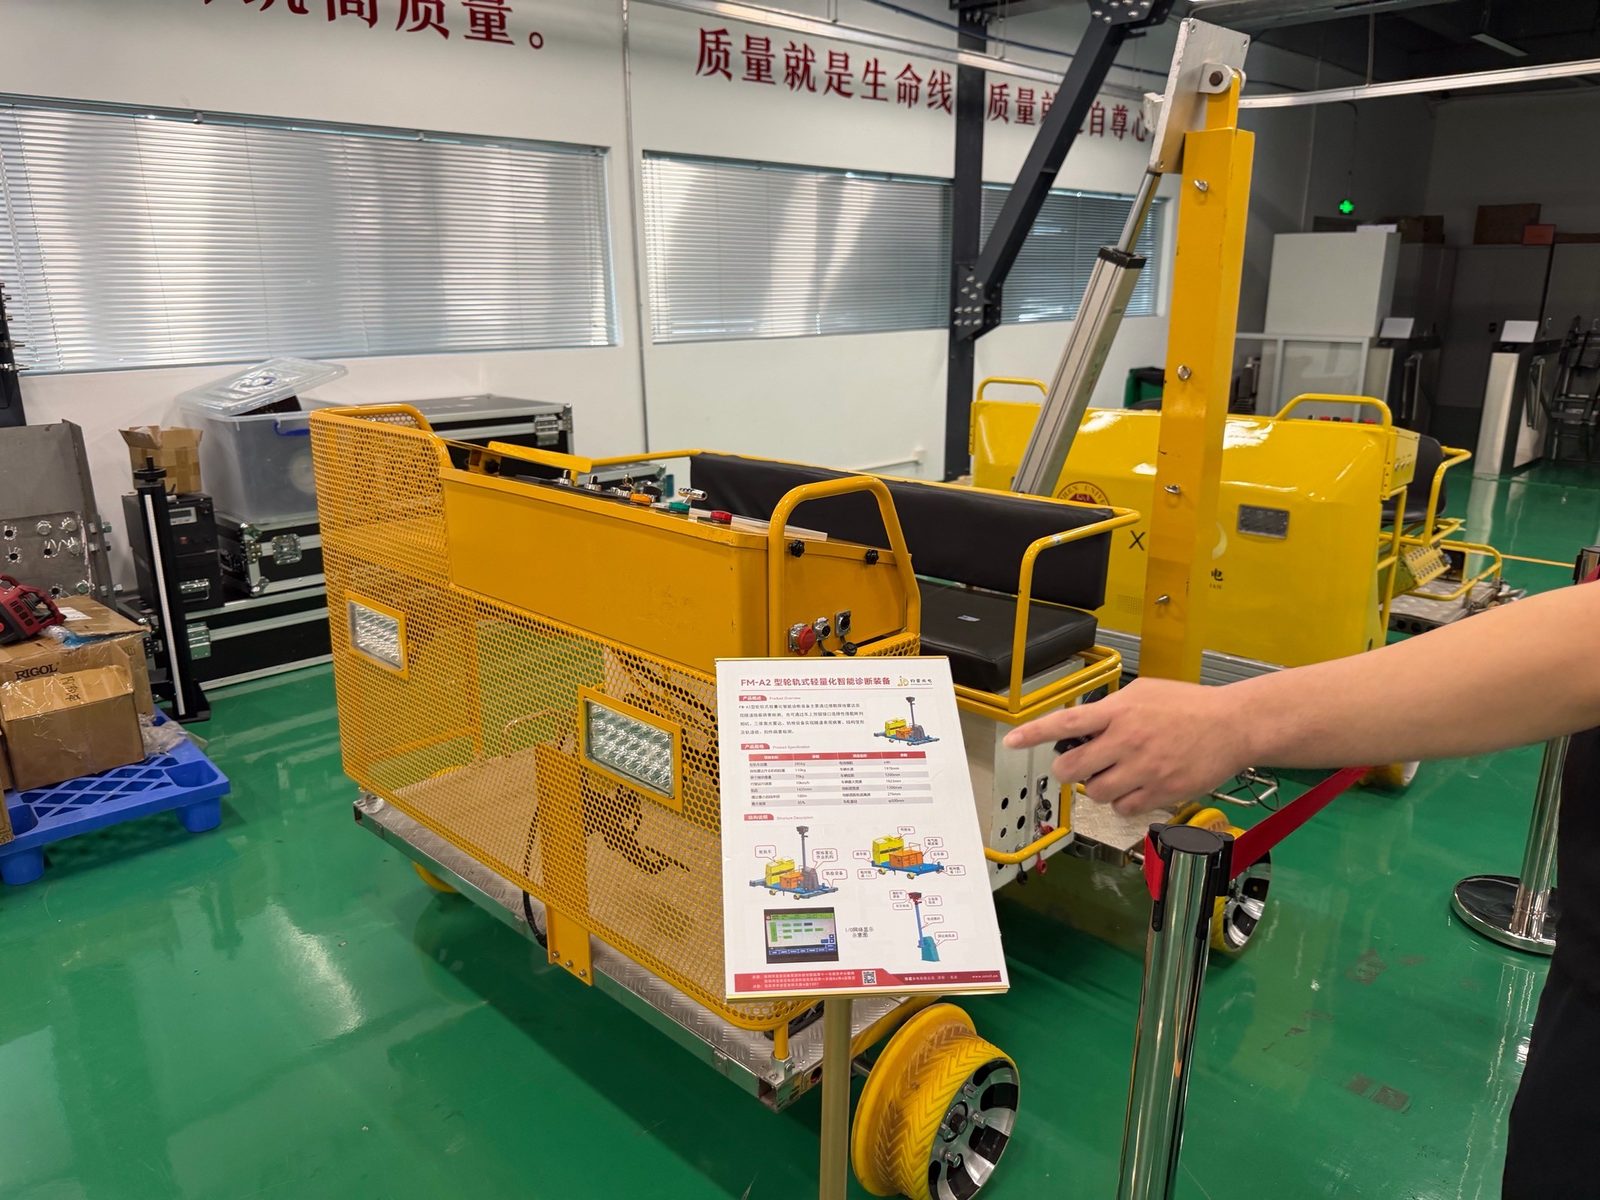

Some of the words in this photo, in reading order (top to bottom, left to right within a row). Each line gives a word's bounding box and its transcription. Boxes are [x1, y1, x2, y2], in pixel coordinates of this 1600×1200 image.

[695, 27, 953, 115] 质量就是生命线
[987, 83, 1150, 142] 质量自尊心
[1129, 530, 1146, 550] X
[1210, 568, 1224, 581] 电
[15, 663, 58, 681] RIGOL
[740, 679, 771, 687] FM-A2
